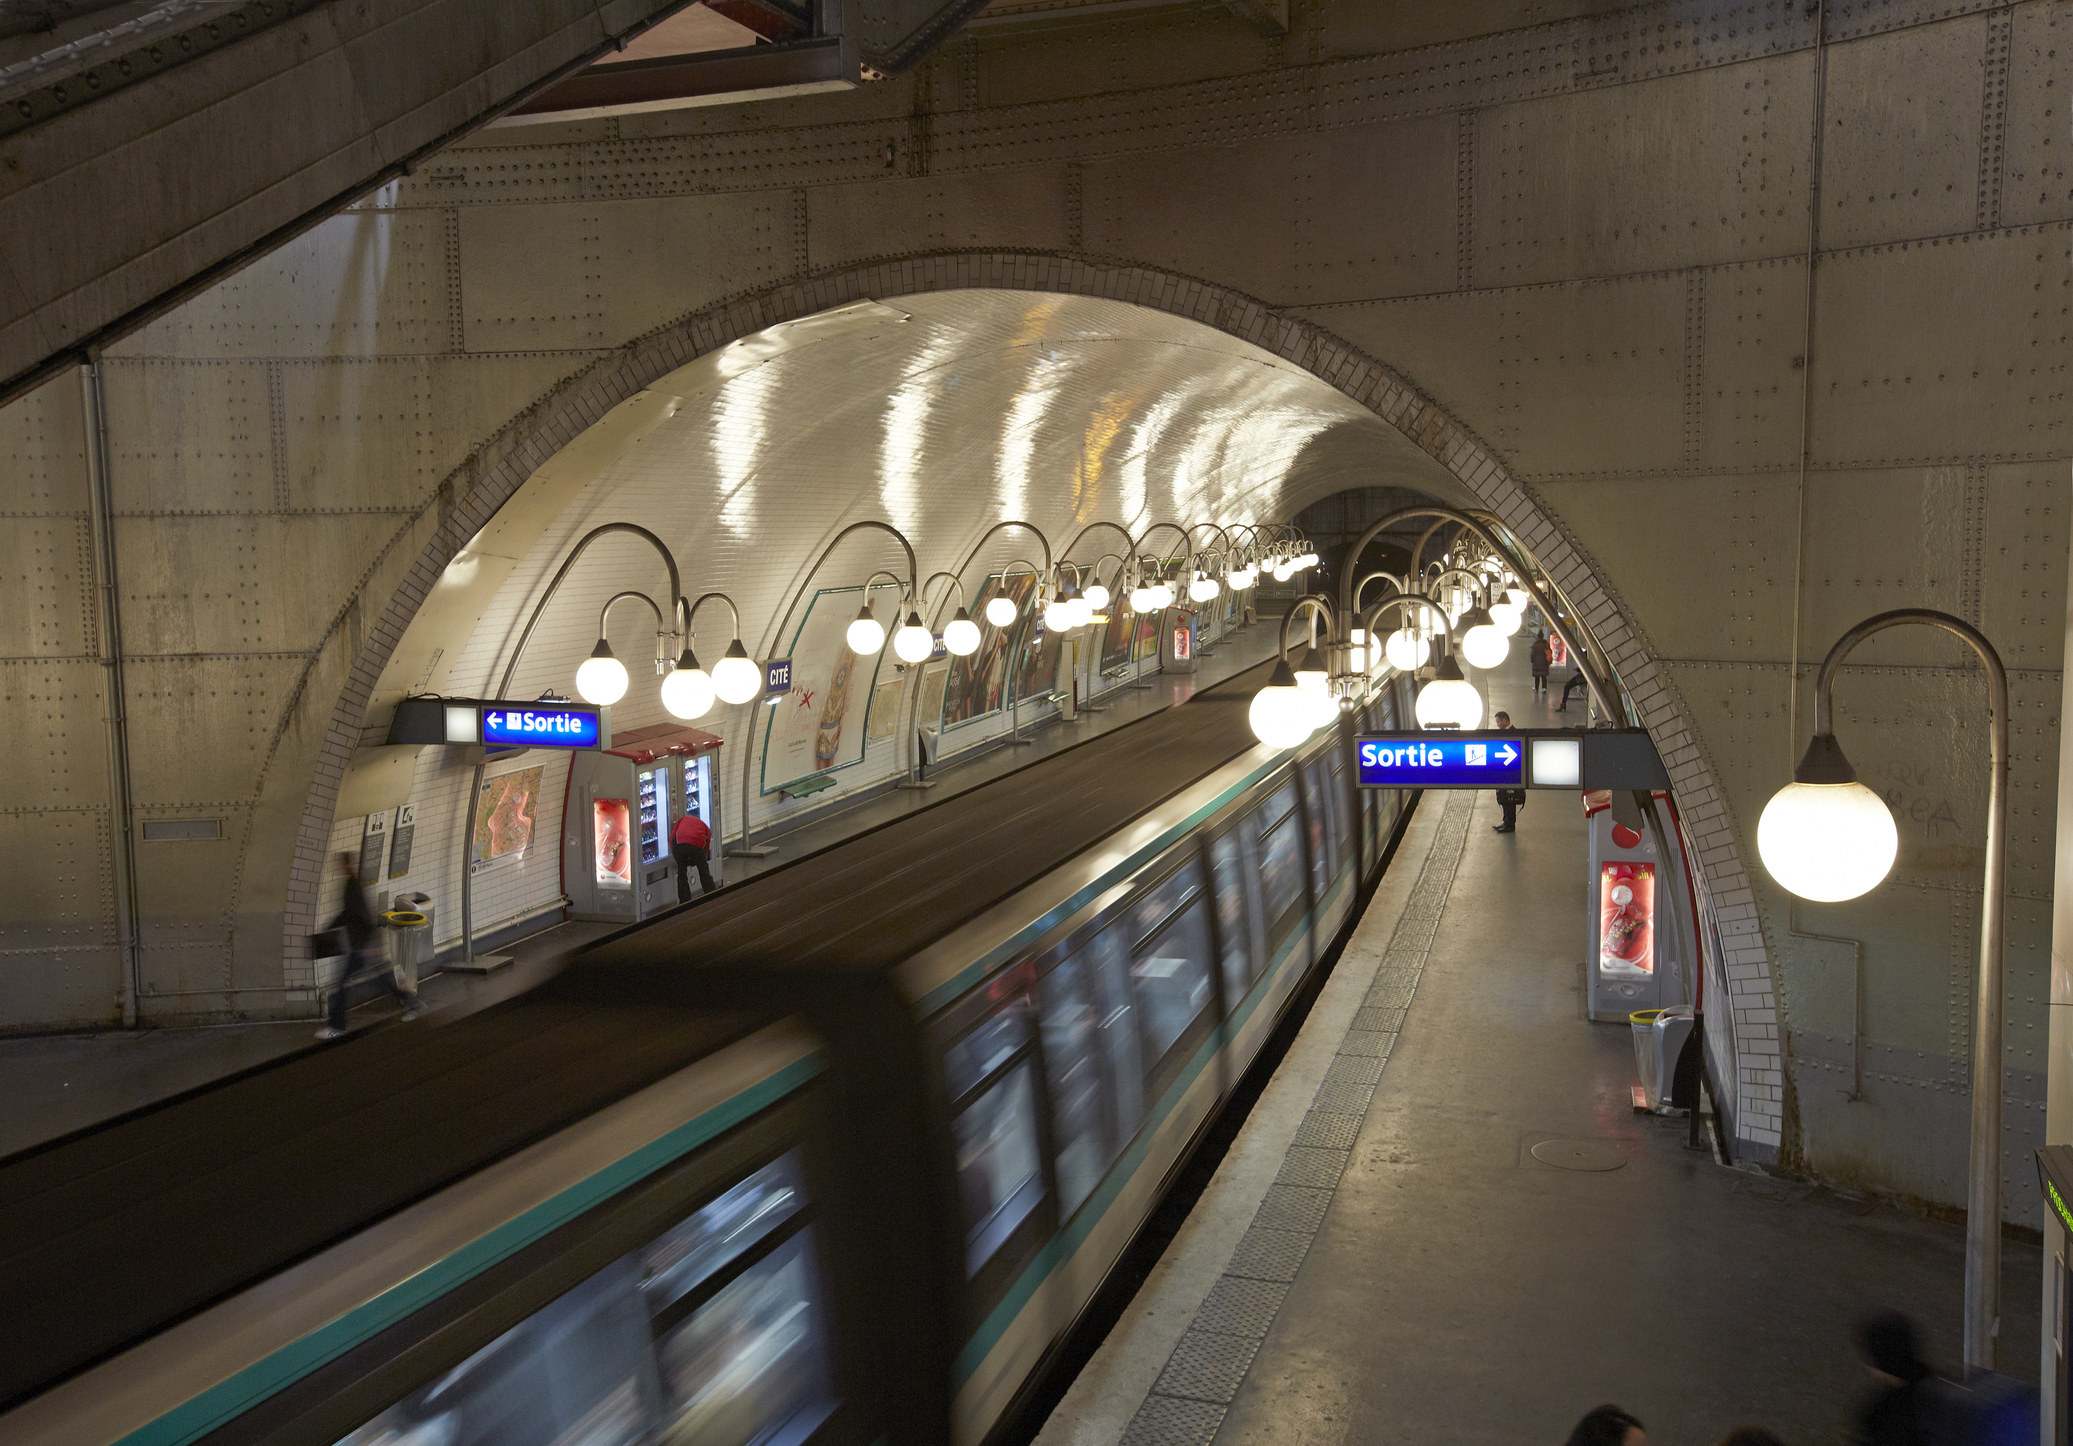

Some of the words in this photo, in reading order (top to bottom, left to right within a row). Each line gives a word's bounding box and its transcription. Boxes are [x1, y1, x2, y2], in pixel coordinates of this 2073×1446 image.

[770, 665, 788, 686] CITÉ
[523, 712, 581, 733] Sortie
[1361, 743, 1443, 767] Sortie
